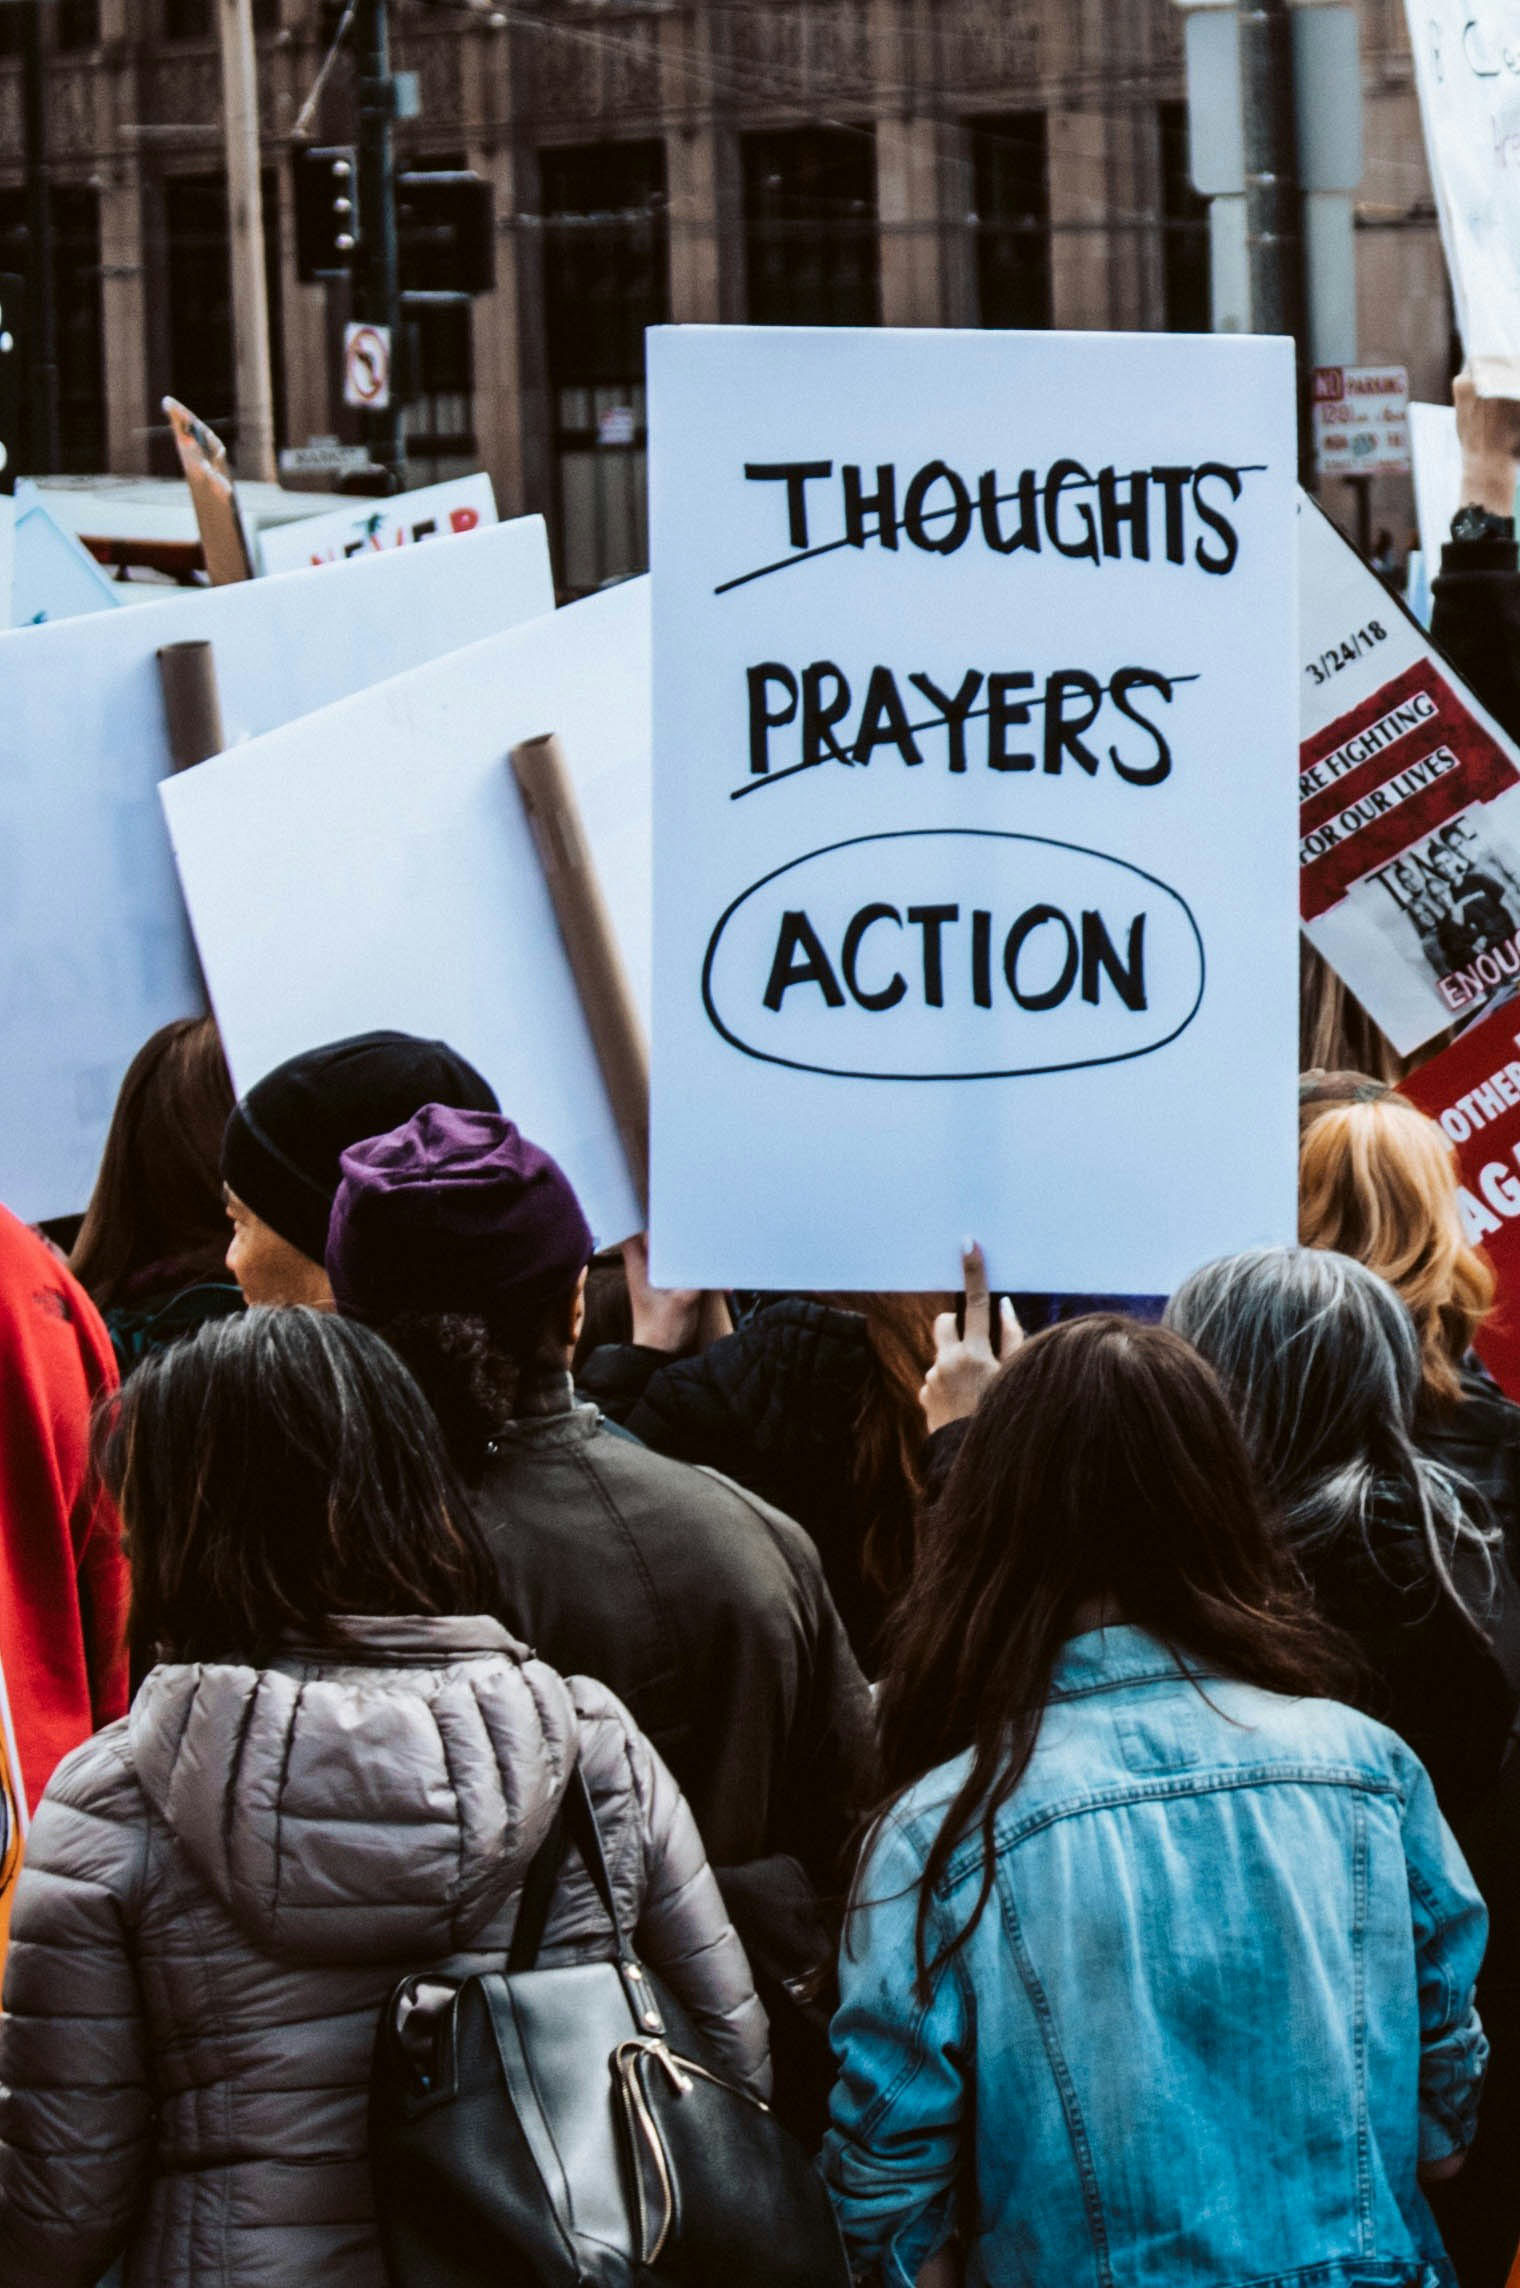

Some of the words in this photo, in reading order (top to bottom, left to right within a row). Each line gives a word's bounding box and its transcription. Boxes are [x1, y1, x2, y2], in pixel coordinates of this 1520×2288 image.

[744, 459, 1244, 575] THOUGHTS
[1305, 621, 1388, 684] 3/24/18
[747, 661, 1174, 786] PRAYERS
[1300, 767, 1328, 801] RE
[1325, 695, 1435, 777] FIGHTING
[1340, 791, 1392, 831] OUR
[1390, 749, 1456, 800] LIVES
[762, 902, 1148, 1012] ACTION
